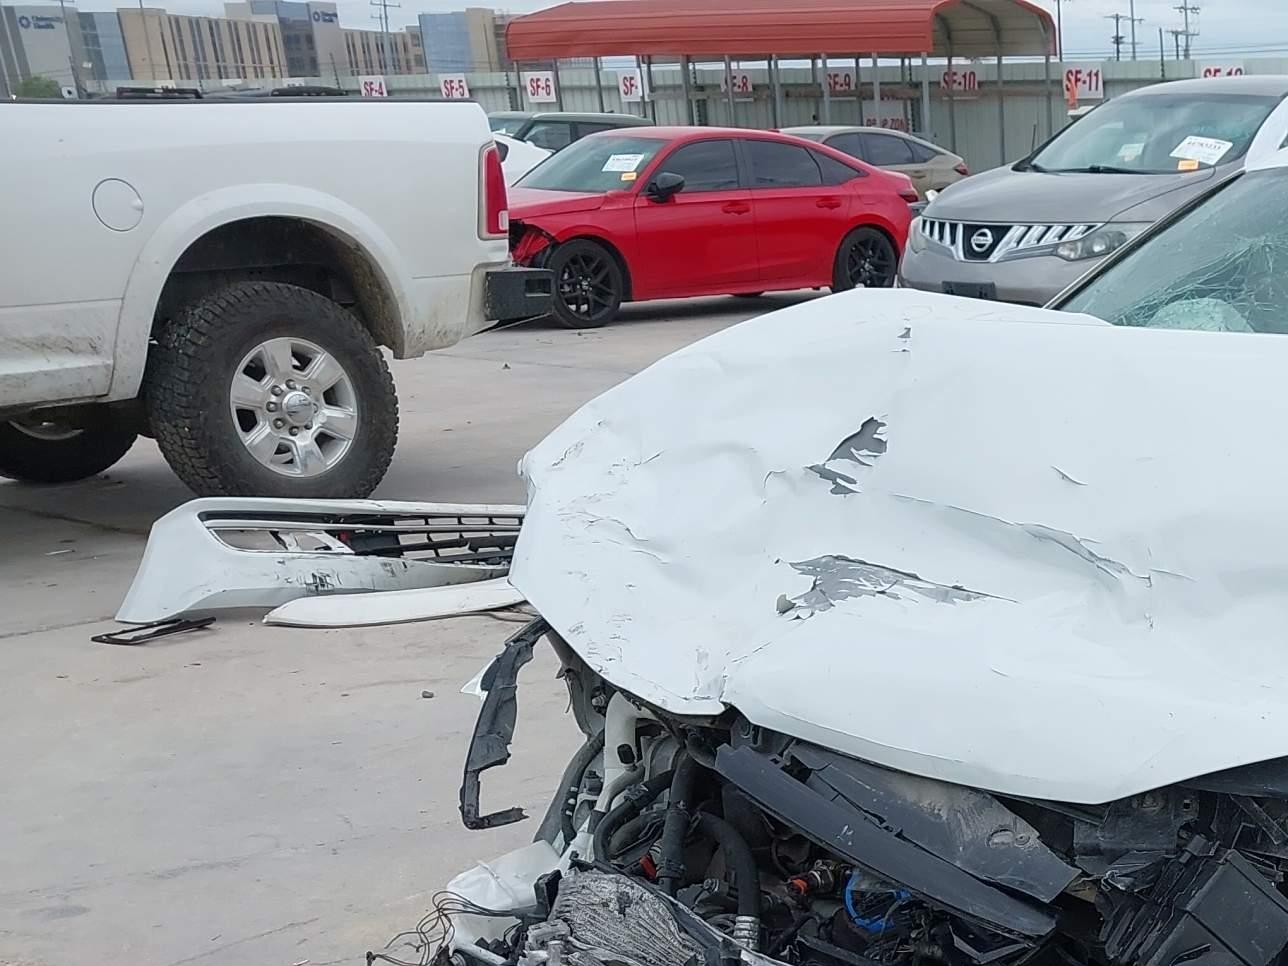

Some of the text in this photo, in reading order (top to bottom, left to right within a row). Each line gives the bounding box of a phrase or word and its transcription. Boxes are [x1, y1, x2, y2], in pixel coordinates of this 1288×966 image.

[363, 81, 385, 97] SF-4
[443, 79, 465, 98] SF-5
[529, 78, 552, 97] SF-6
[725, 75, 749, 92] F-8
[942, 71, 977, 92] SF-10
[1065, 69, 1100, 92] SF-11
